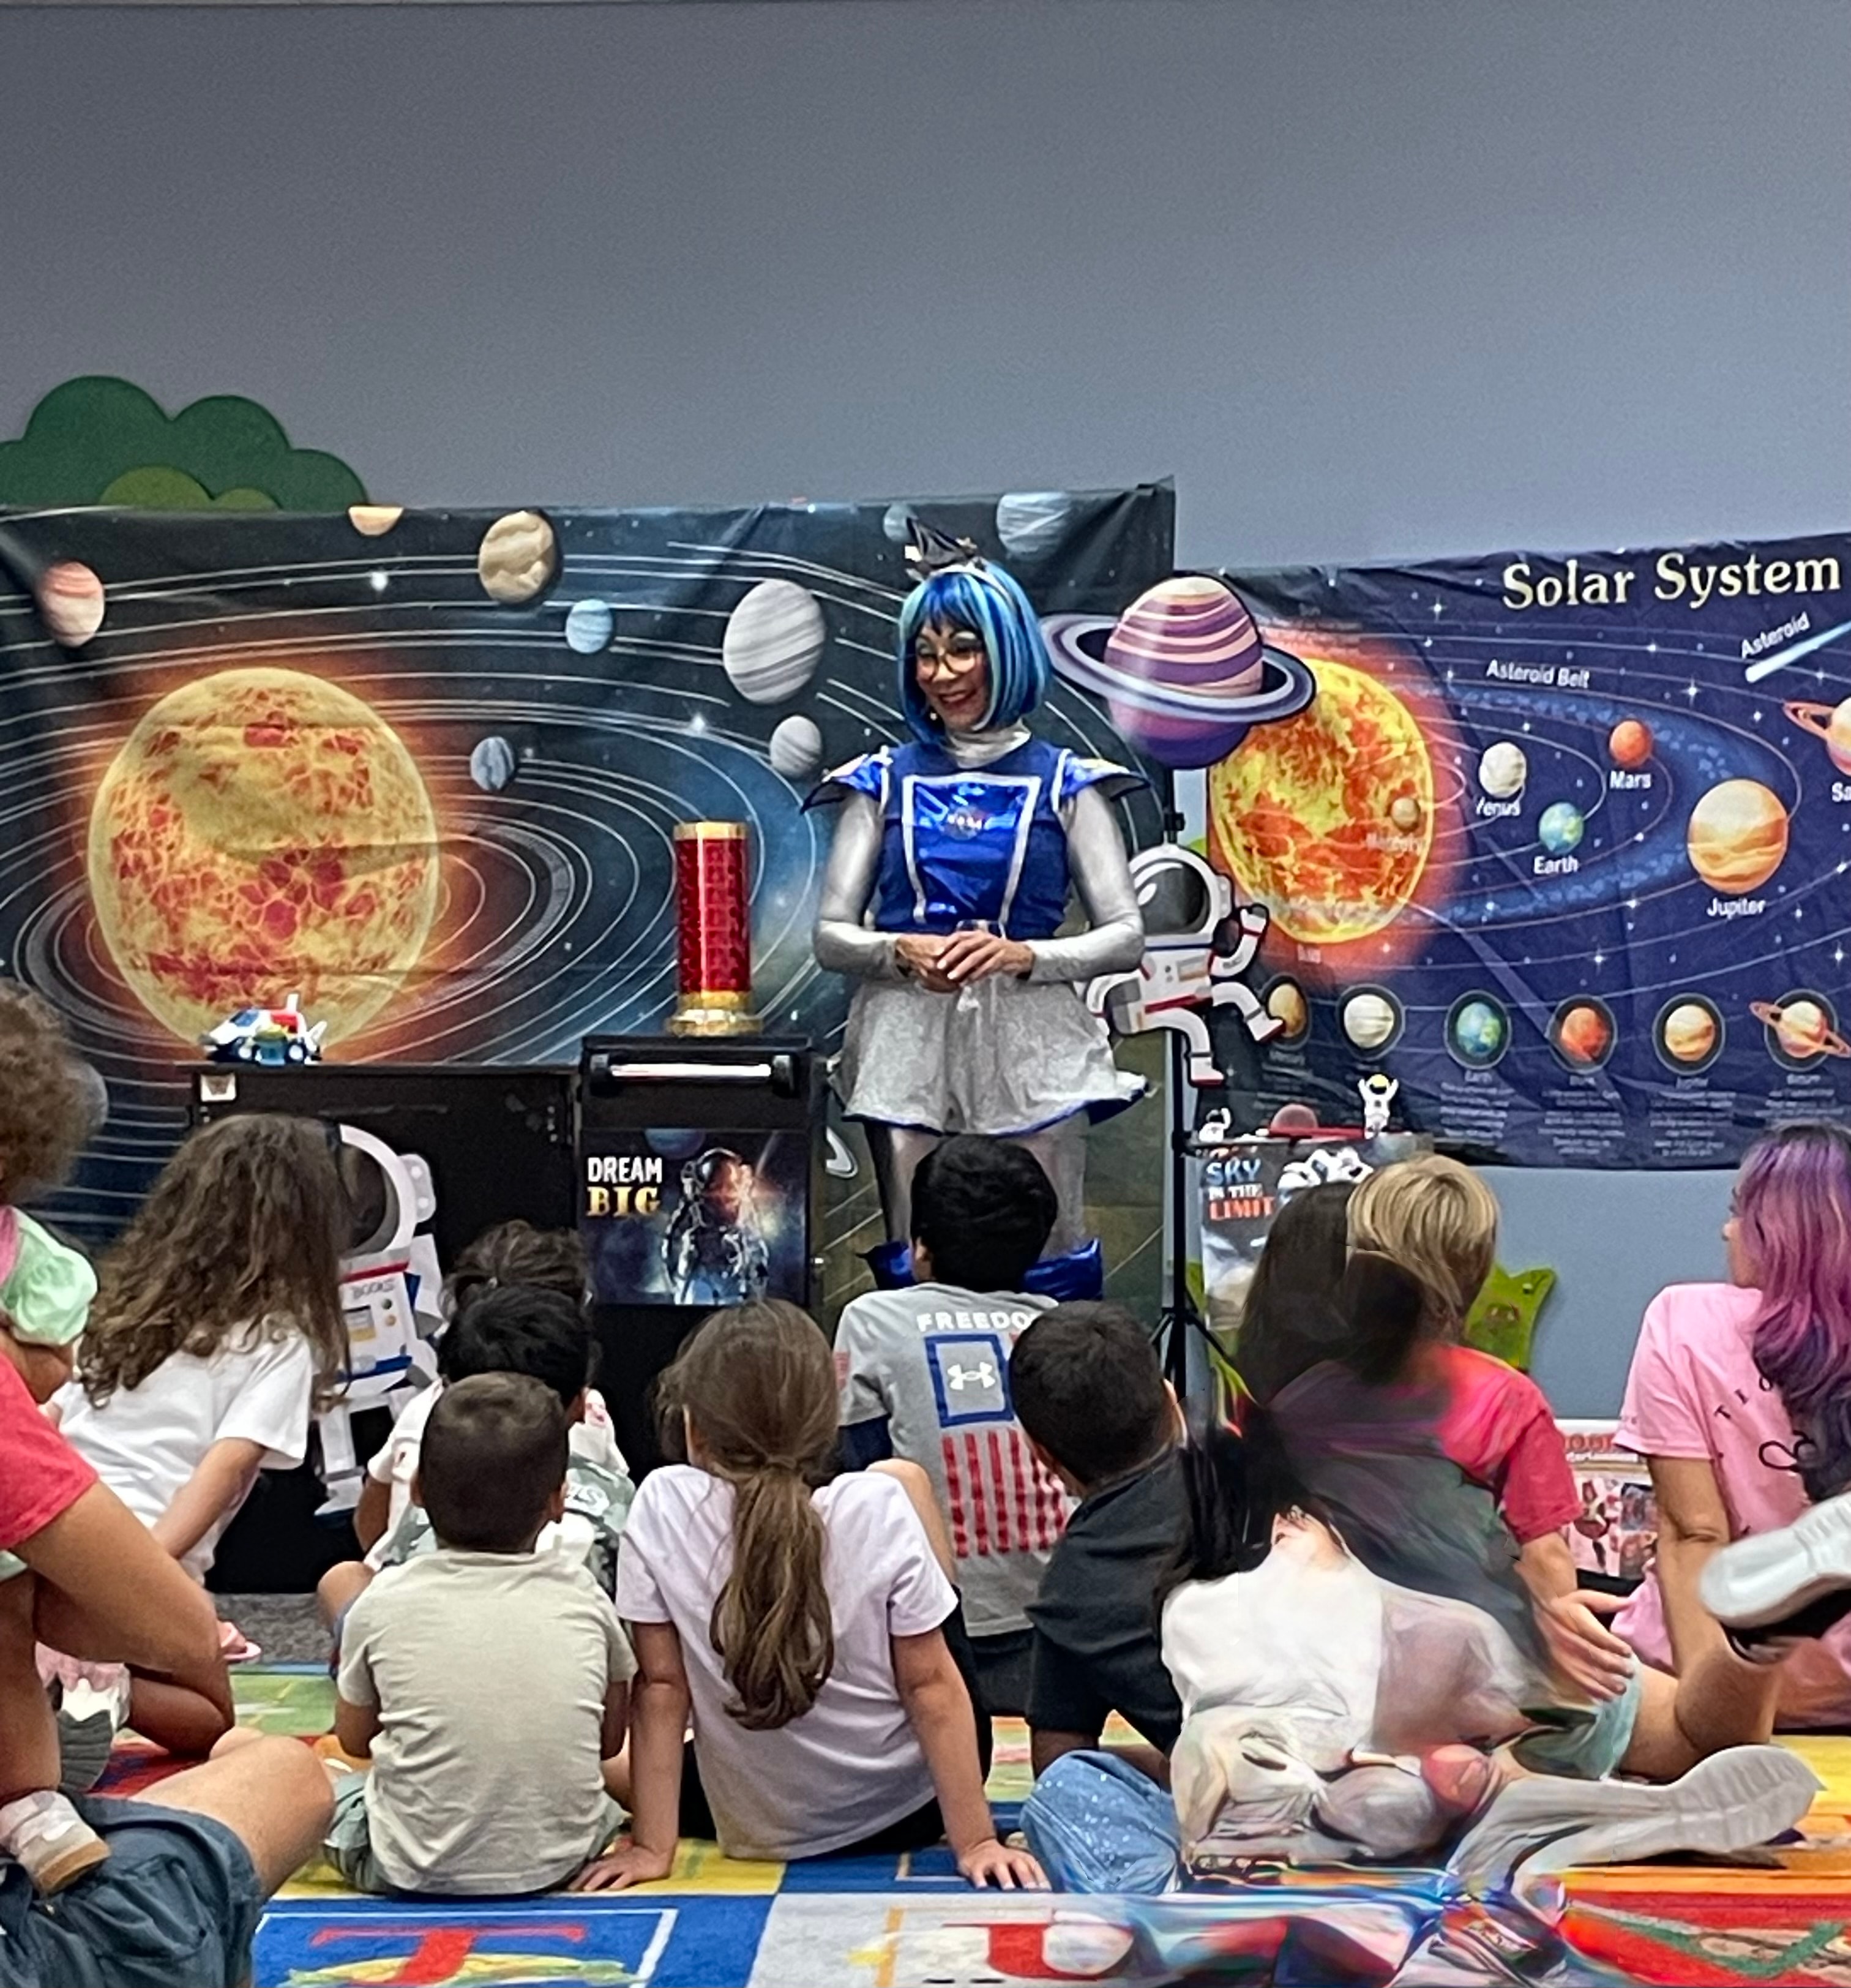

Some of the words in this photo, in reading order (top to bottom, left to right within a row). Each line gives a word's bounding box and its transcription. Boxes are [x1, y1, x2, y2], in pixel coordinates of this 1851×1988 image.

[1502, 558, 1636, 610] Solar
[1654, 552, 1841, 610] System
[1741, 610, 1811, 659] Asteroid
[1486, 658, 1556, 685] Asteroid
[1557, 667, 1590, 689] Belt
[1609, 770, 1652, 789] Mars
[1533, 854, 1579, 874] Earth
[1706, 897, 1767, 920] Jupiter
[588, 1155, 662, 1184] DREAM
[1205, 1156, 1262, 1186] SKY
[586, 1186, 661, 1217] BIG
[1209, 1196, 1276, 1221] LIMIT
[916, 1310, 1042, 1332] FREEDO
